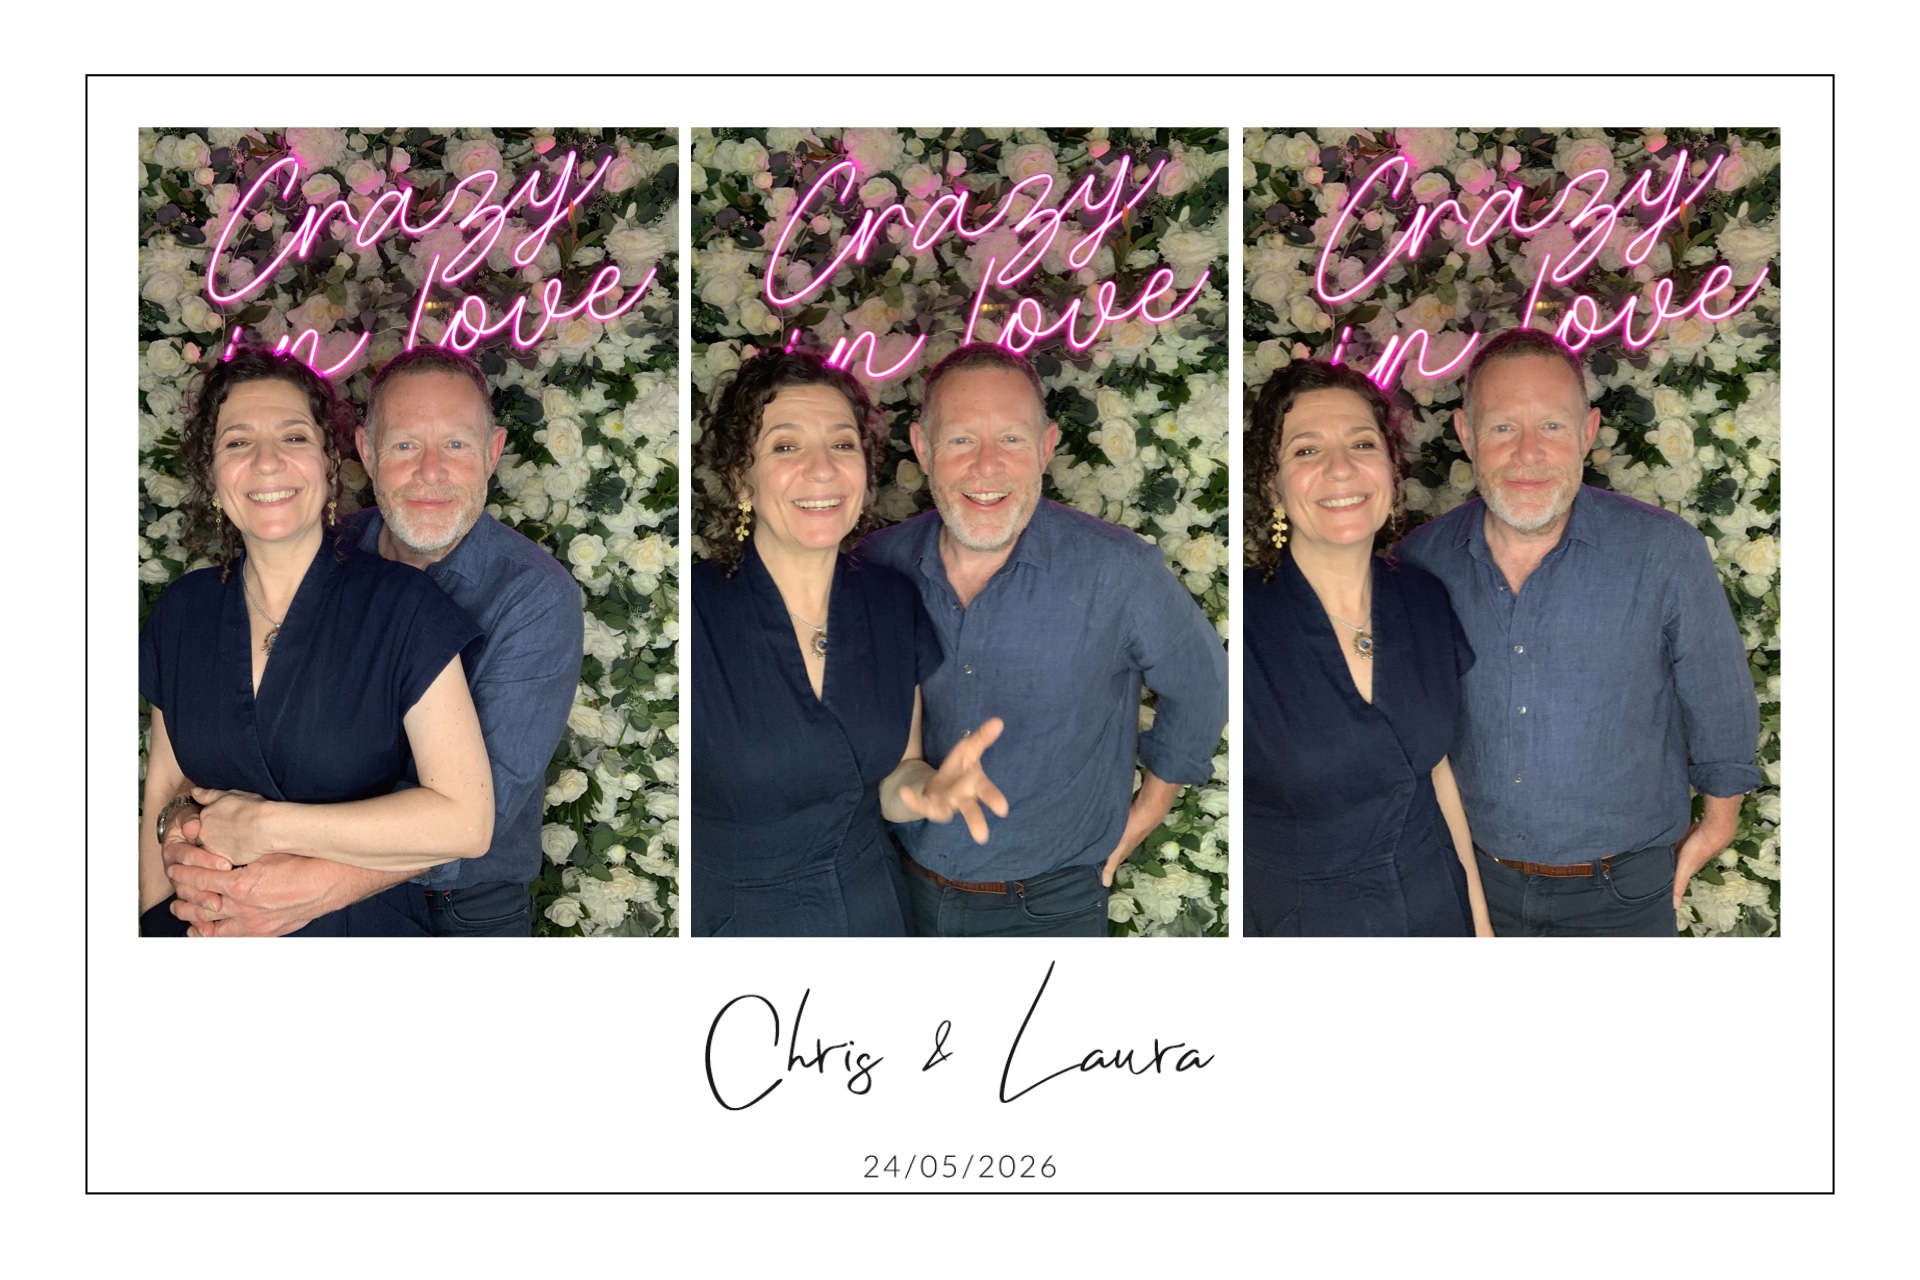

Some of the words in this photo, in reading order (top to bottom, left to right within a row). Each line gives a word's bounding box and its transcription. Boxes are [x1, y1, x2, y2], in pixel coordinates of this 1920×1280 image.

[206, 147, 613, 303] Crazy
[764, 153, 1167, 306] Crazy
[1315, 148, 1725, 303] Crazy
[405, 252, 658, 353] love
[963, 255, 1211, 355] love
[1522, 250, 1770, 353] love
